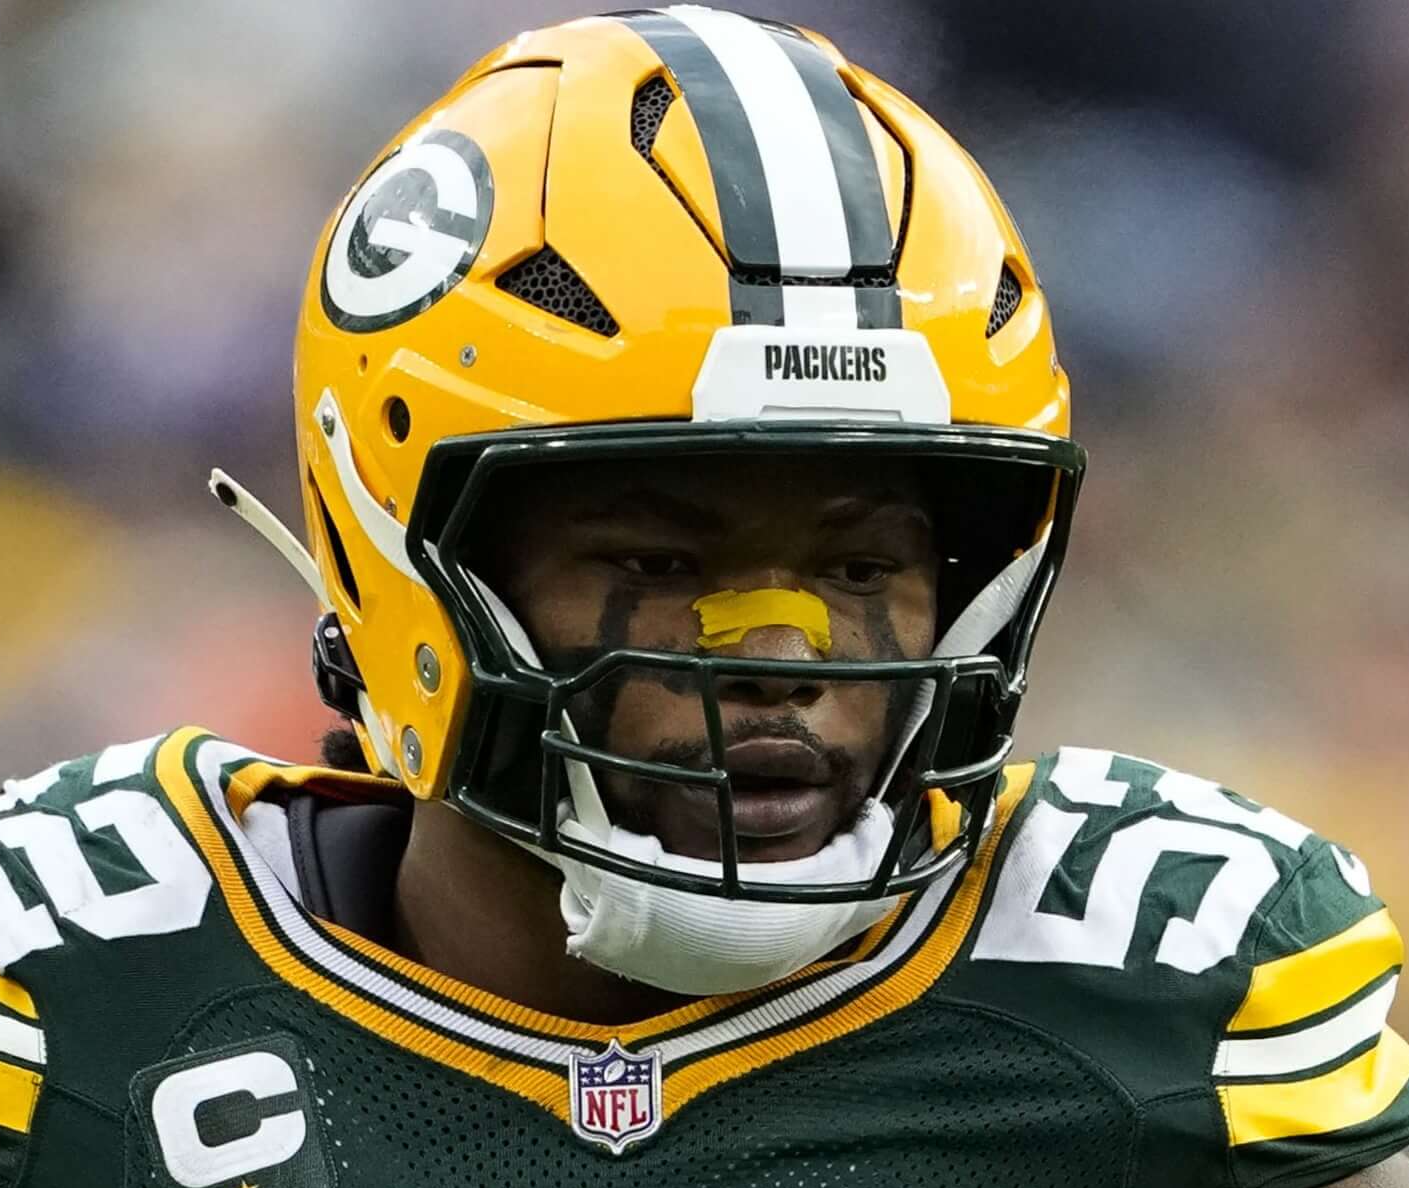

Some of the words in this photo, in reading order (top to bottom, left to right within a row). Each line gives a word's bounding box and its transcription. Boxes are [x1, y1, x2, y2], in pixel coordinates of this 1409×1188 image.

[326, 143, 478, 316] G
[764, 344, 887, 382] PACKERS
[152, 1051, 306, 1188] C
[585, 1089, 647, 1132] NFL
